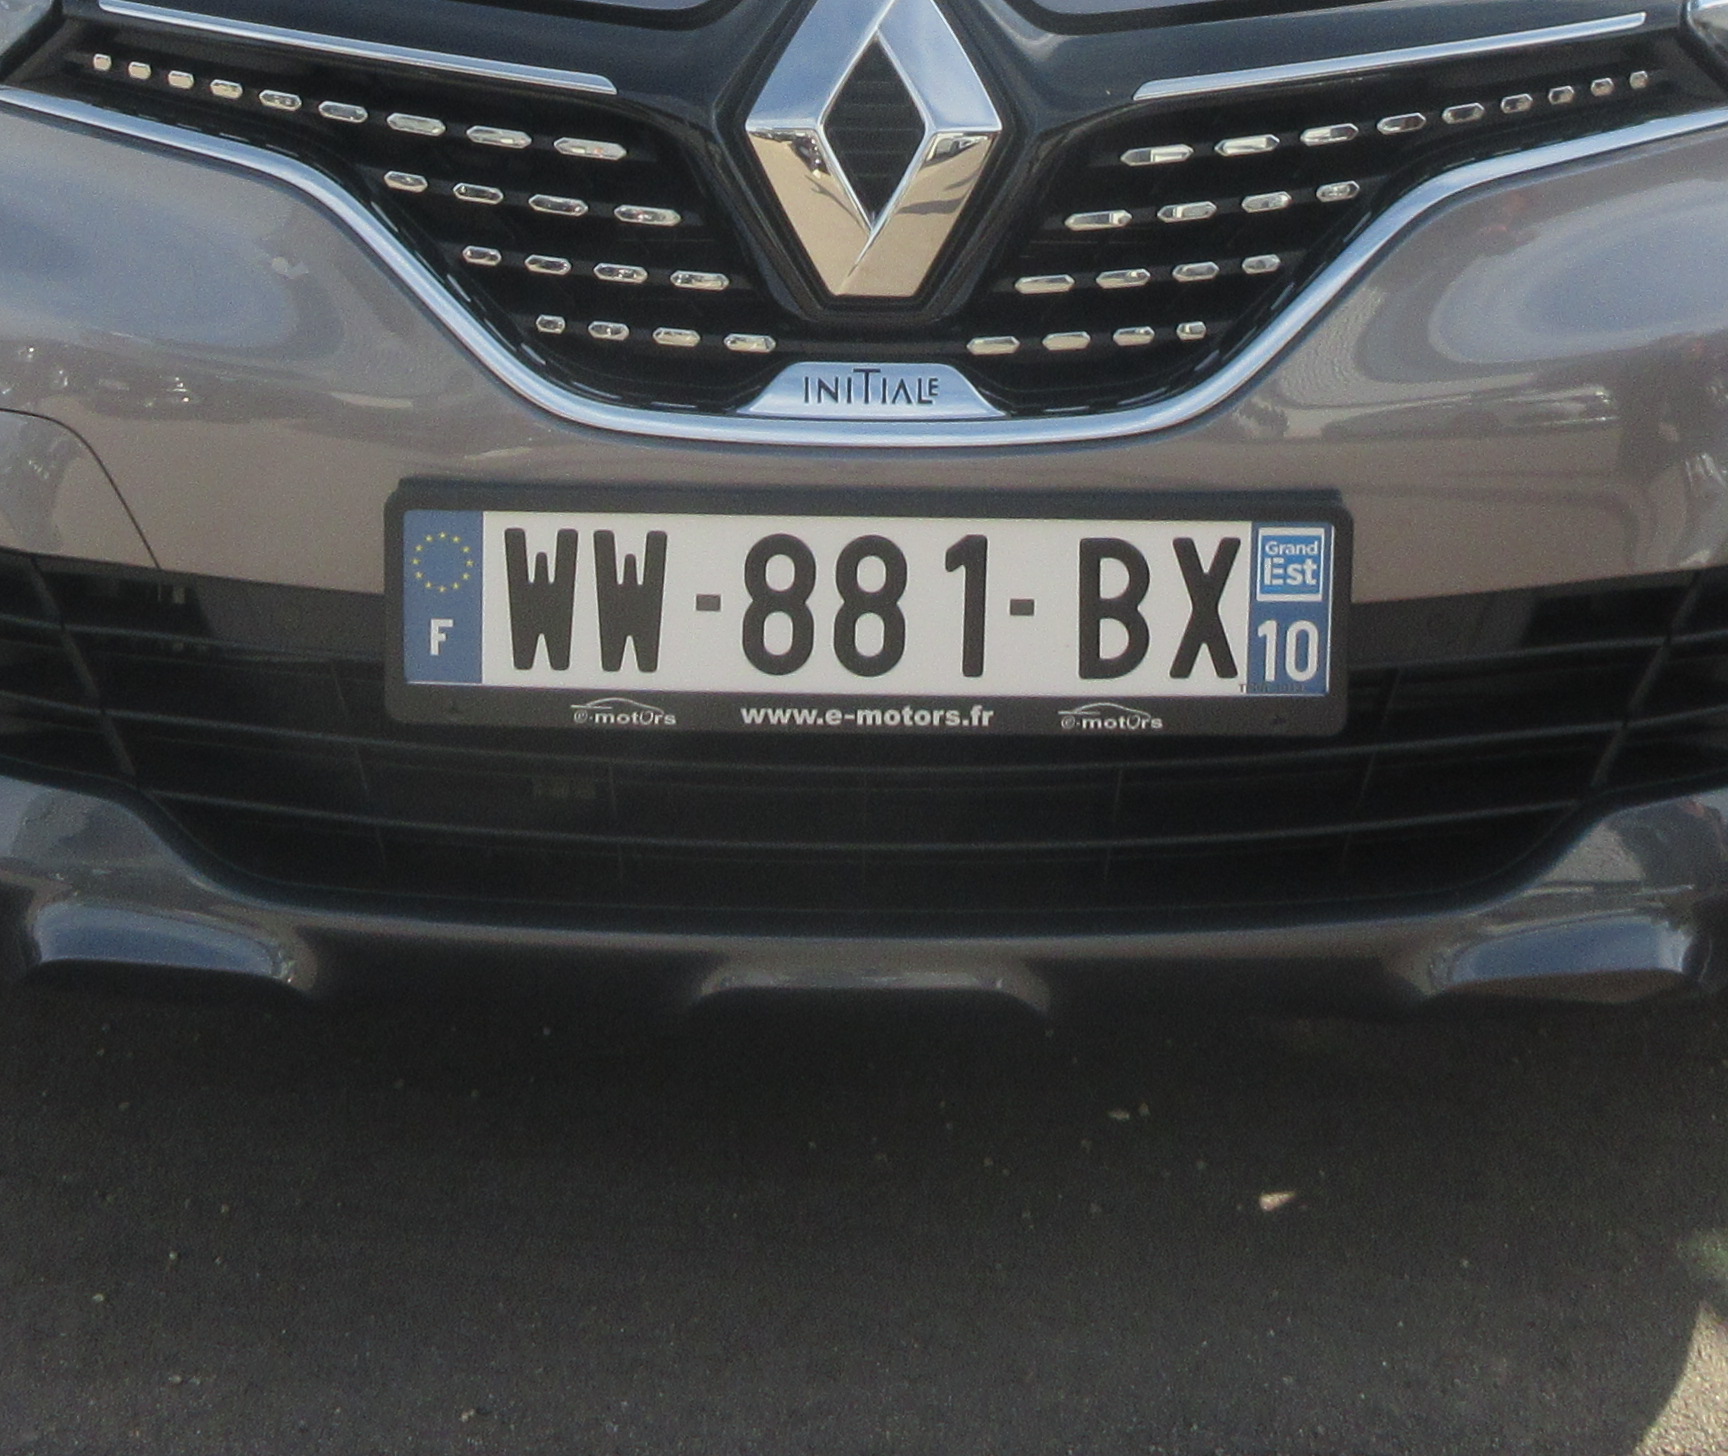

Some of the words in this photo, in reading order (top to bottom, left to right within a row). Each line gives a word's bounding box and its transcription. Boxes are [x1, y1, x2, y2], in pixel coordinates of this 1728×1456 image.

[802, 368, 939, 405] INITIALE
[1264, 540, 1319, 556] Grand
[1263, 557, 1318, 586] Est
[429, 617, 455, 657] F
[1257, 619, 1319, 682] 10
[739, 704, 995, 727] www.e-motors.fr
